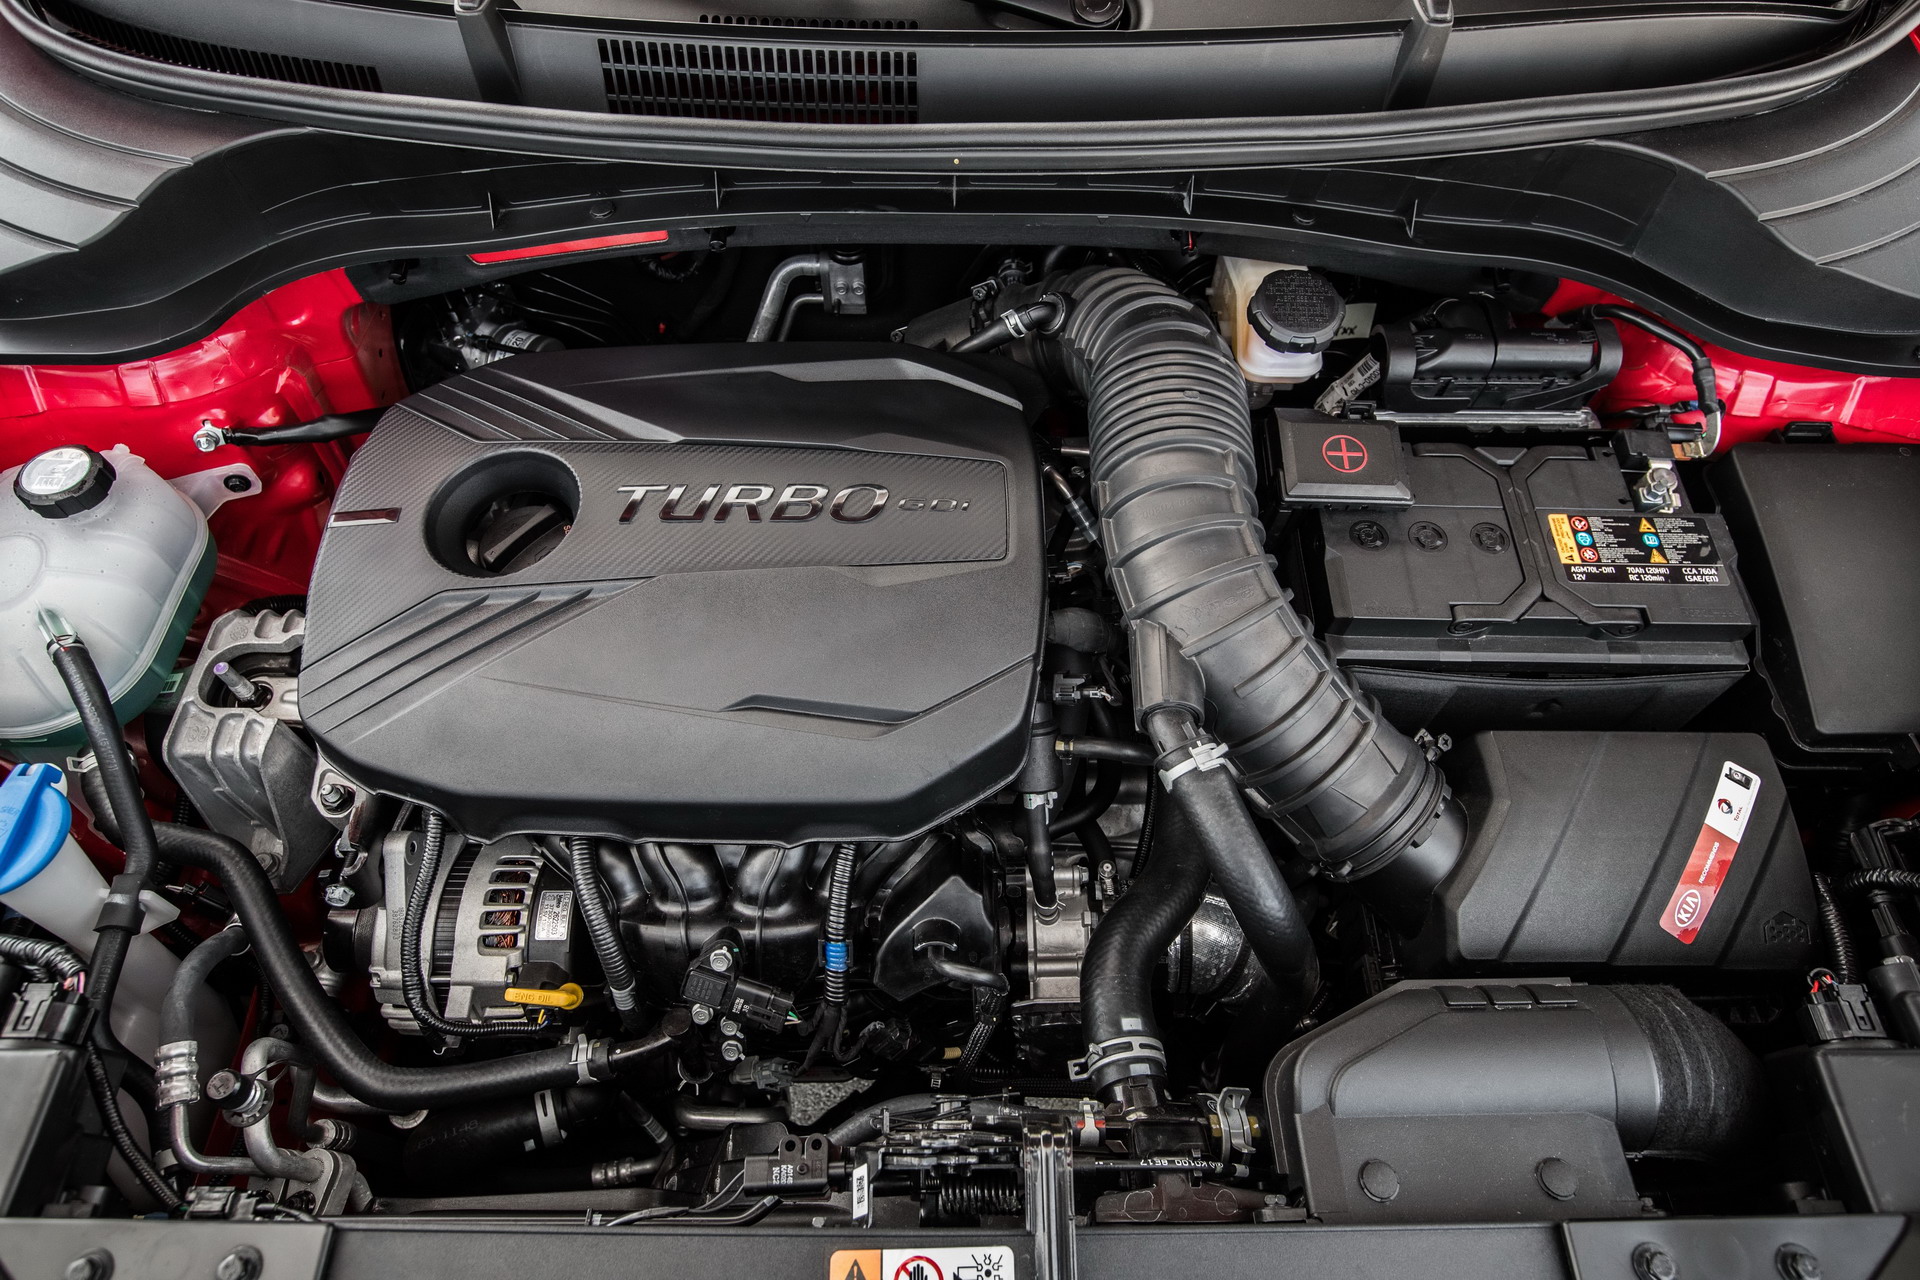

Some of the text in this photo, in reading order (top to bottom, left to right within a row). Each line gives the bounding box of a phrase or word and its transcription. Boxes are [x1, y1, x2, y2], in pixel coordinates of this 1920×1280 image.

[616, 483, 970, 525] TURBO GDI
[1734, 806, 1743, 821] TOTAL
[1698, 841, 1720, 884] RECOMMENDS
[1677, 894, 1700, 923] KIA
[513, 992, 553, 1003] ENG OIL
